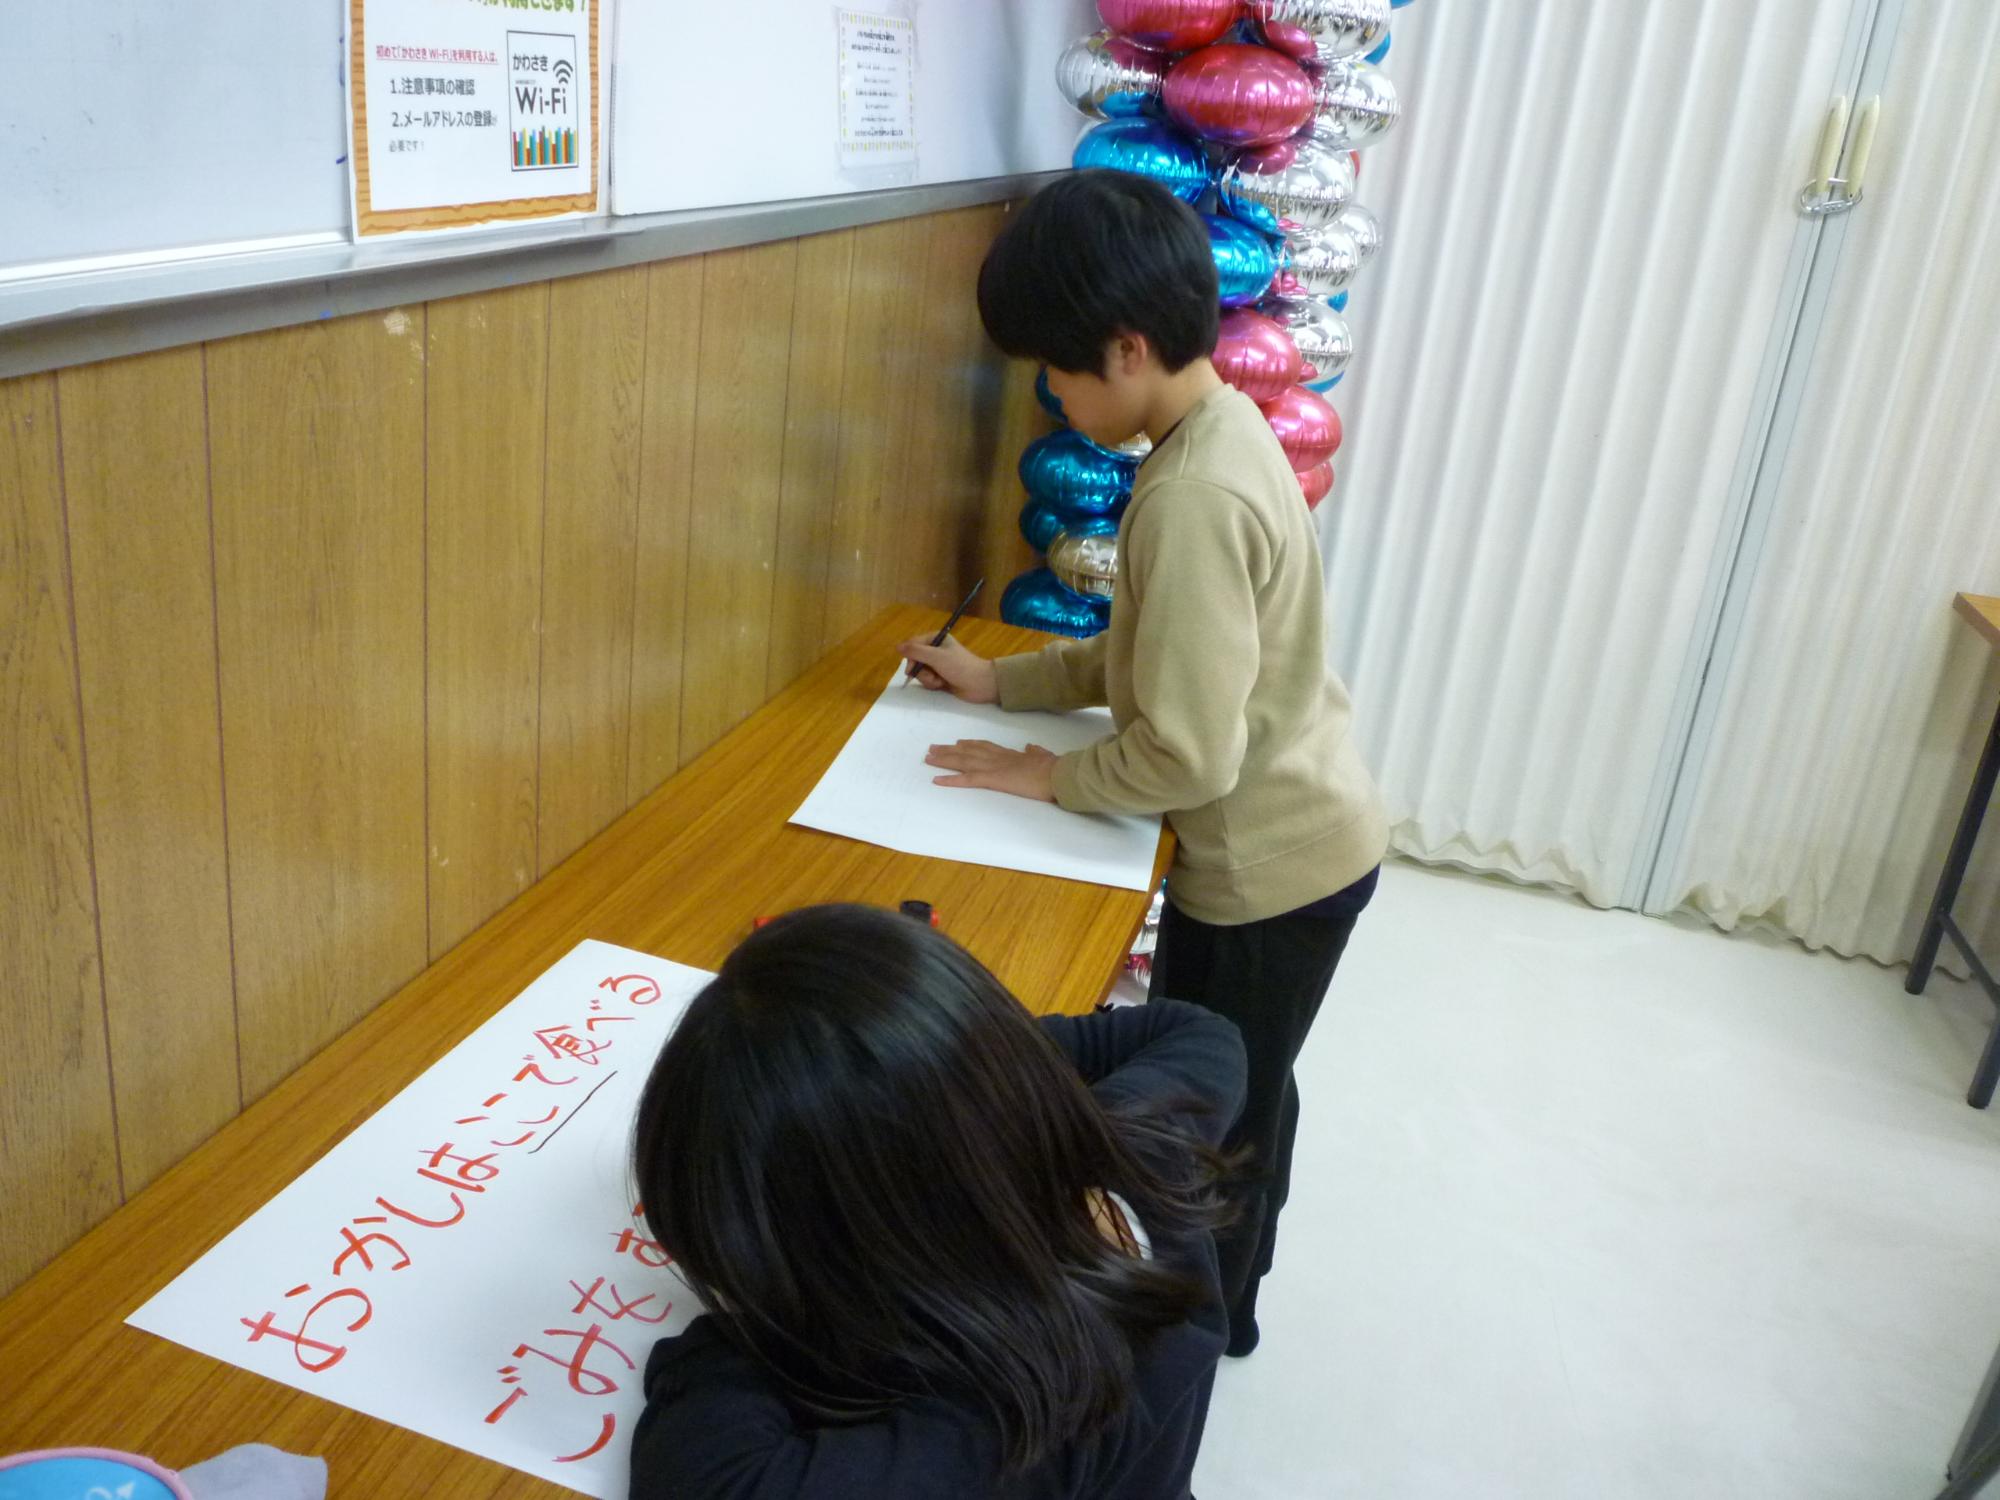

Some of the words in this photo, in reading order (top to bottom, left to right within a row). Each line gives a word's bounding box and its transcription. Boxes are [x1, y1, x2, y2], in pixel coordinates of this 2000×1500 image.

[512, 53, 549, 72] かわさき
[390, 77, 476, 95] 1.注意事項の確認
[515, 86, 567, 114] Wi-Fi
[240, 974, 661, 1373] おかしはここで食べる
